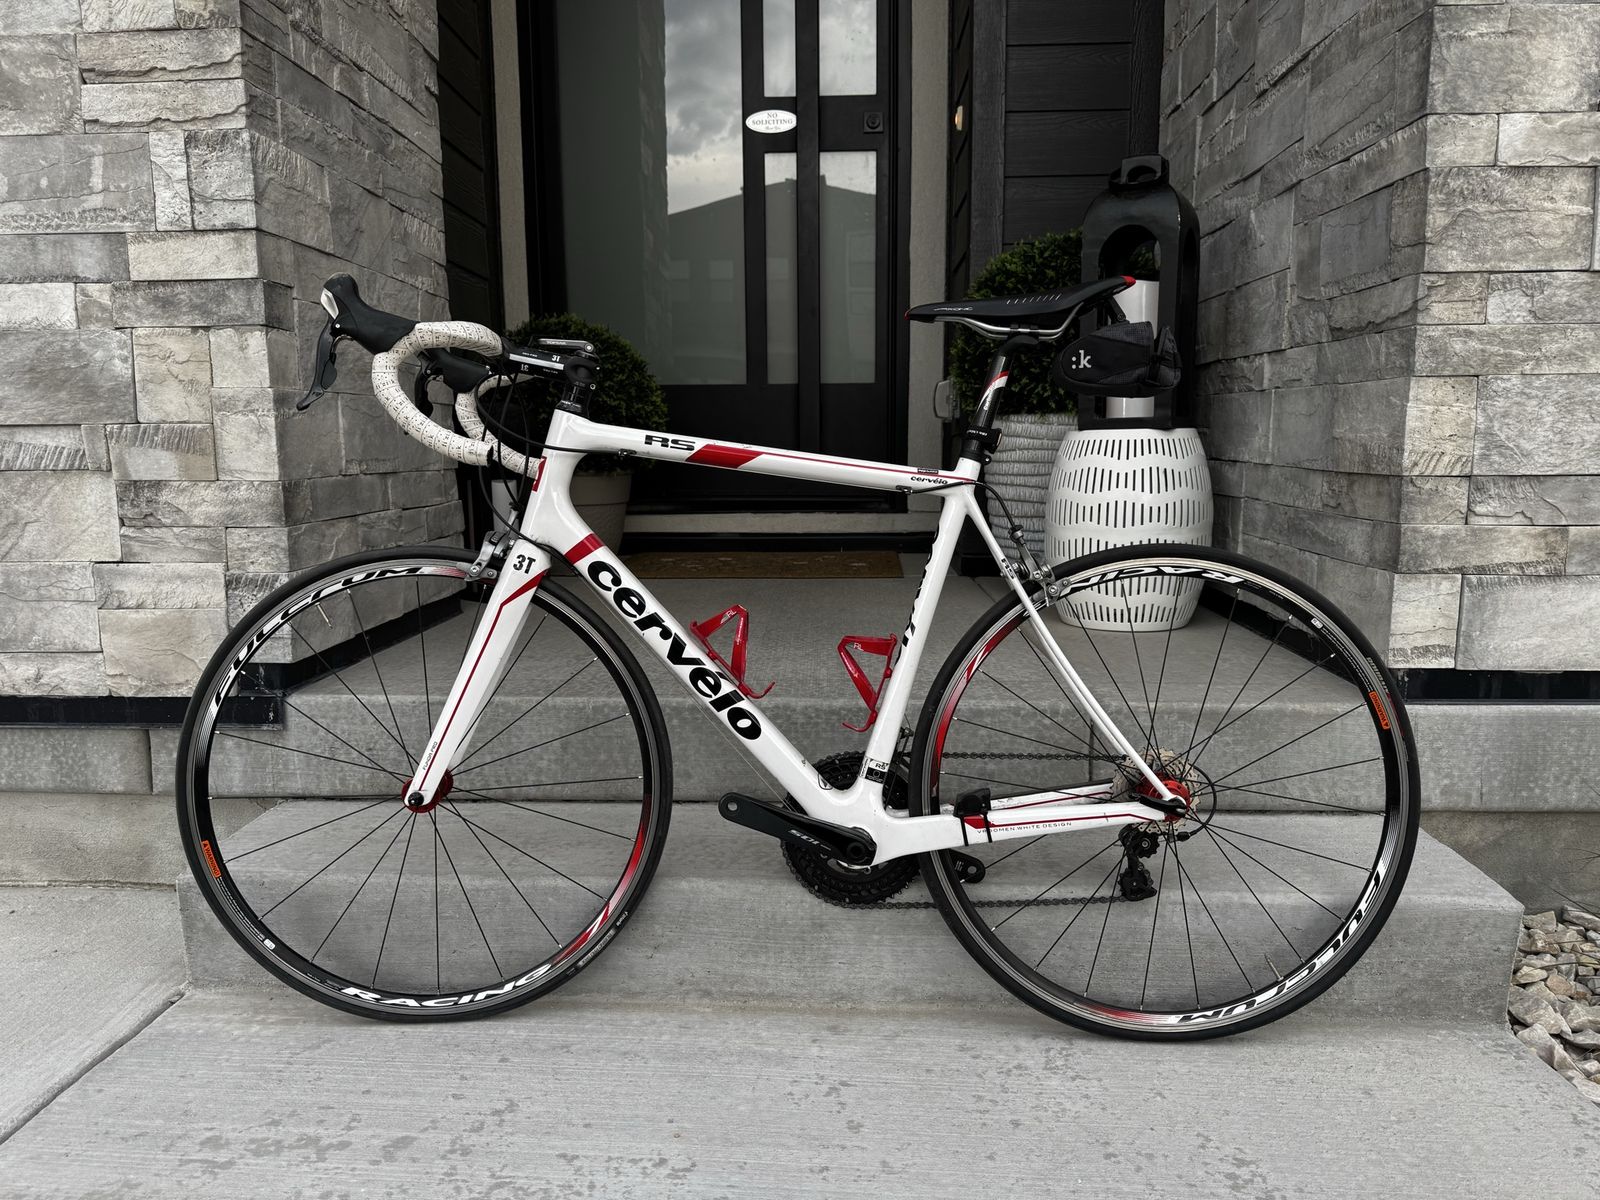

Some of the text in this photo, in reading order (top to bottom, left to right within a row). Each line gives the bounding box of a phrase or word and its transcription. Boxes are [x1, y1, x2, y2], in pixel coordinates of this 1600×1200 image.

[644, 434, 696, 450] RS
[513, 554, 537, 575] 3T
[214, 566, 425, 707] FULCRUM
[587, 560, 762, 740] cervélo
[341, 963, 552, 1007] RACING
[1177, 870, 1381, 1024] FULCRUM
